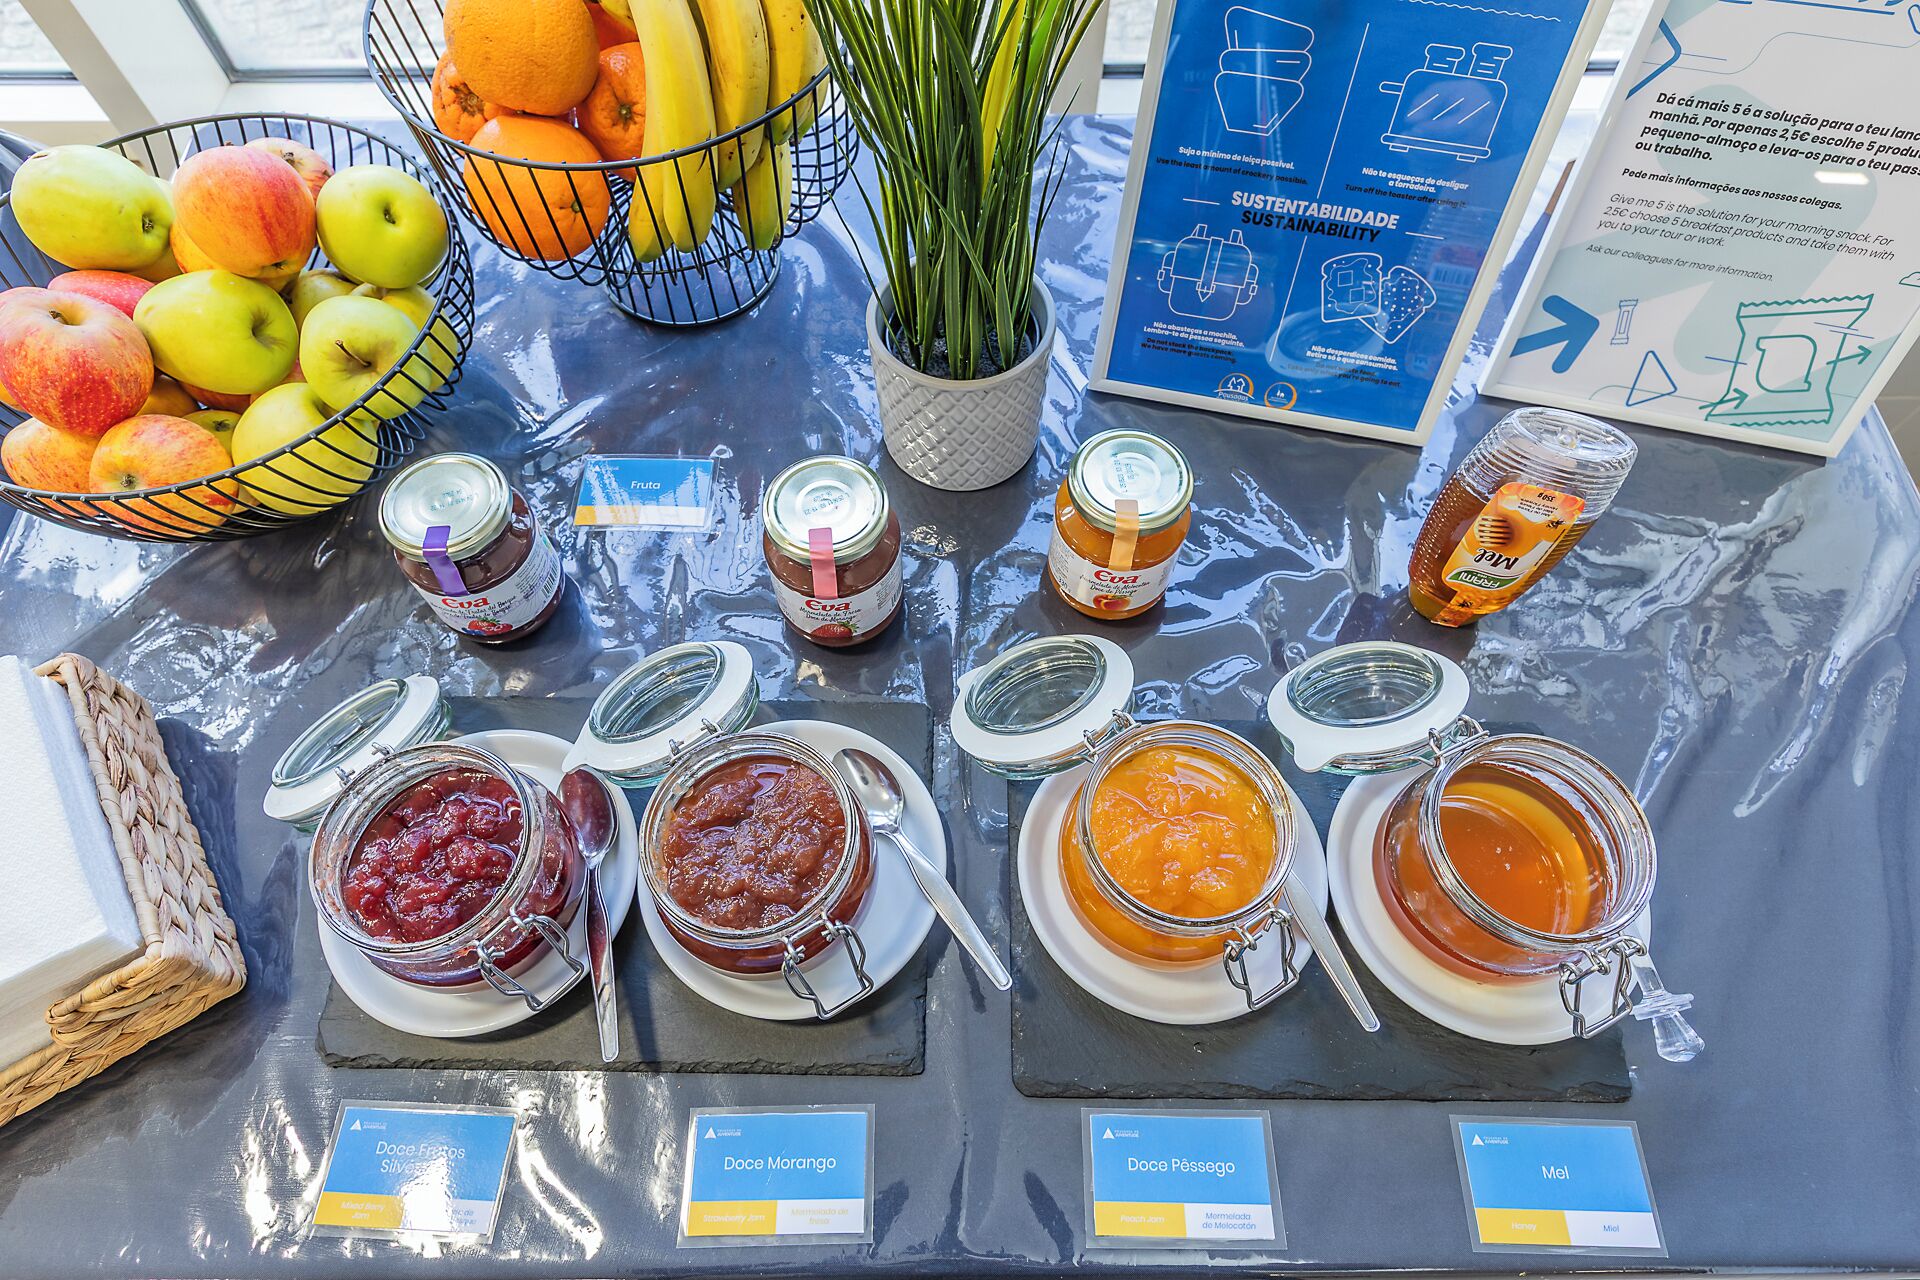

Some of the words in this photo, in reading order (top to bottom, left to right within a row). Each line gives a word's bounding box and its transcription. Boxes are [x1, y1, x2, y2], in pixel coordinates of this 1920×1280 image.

[1656, 92, 1676, 105] Dá
[1677, 96, 1694, 107] cá
[1695, 100, 1730, 112] mais
[1732, 103, 1742, 114] 5
[1742, 104, 1752, 116] é
[1753, 109, 1763, 118] a
[1763, 110, 1819, 127] solução
[1817, 119, 1854, 131] para
[1855, 124, 1864, 133] o
[1865, 124, 1890, 137] teu
[1649, 110, 1700, 126] manhã.
[1702, 116, 1726, 129] Por
[1726, 122, 1778, 138] apenas
[1779, 128, 1810, 142] 2,5€
[1810, 135, 1864, 150] escolhe
[1866, 141, 1877, 151] 5
[1874, 144, 1920, 159] produ
[1634, 139, 1653, 152] ou
[1653, 142, 1713, 161] trabalho.
[1640, 126, 1758, 152] pequeno-almoço
[1758, 144, 1768, 152] e
[1768, 143, 1821, 160] leva-os
[1820, 153, 1856, 165] para
[1856, 159, 1866, 167] o
[1867, 158, 1891, 171] teu
[1622, 168, 1648, 179] Pede
[1648, 173, 1674, 183] mais
[1674, 175, 1741, 194] informações
[1741, 189, 1760, 197] aos
[1761, 192, 1798, 203] nossos
[1799, 196, 1843, 210] colegas.
[1231, 191, 1400, 230] SUSTENTABILIDADE
[1610, 193, 1636, 205] Give
[1635, 198, 1655, 208] me
[1656, 201, 1665, 210] 5
[1665, 201, 1676, 211] is
[1676, 203, 1696, 215] the
[1696, 207, 1741, 222] solution
[1741, 213, 1759, 224] for
[1758, 218, 1786, 230] your
[1785, 222, 1836, 239] morning
[1835, 229, 1872, 244] snack.
[1873, 235, 1895, 247] For
[1241, 210, 1381, 242] SUSTAINABILITY
[1597, 219, 1620, 230] you
[1620, 222, 1632, 231] to
[1632, 225, 1660, 237] your
[1659, 228, 1684, 240] tour
[1683, 234, 1698, 242] or
[1697, 236, 1725, 247] work.
[1629, 210, 1670, 224] choose
[1671, 216, 1681, 226] 5
[1680, 217, 1734, 235] breakfast
[1731, 227, 1785, 243] products
[1785, 235, 1810, 247] and
[1810, 240, 1836, 251] take
[1836, 243, 1868, 256] them
[1869, 249, 1895, 261] with
[1586, 244, 1602, 253] Ask
[1603, 247, 1621, 256] our
[1621, 249, 1674, 265] colleagues
[1673, 257, 1689, 268] for
[1689, 261, 1716, 272] more
[1715, 264, 1774, 282] information.
[630, 480, 661, 490] Fruta
[1474, 547, 1519, 571] Mel
[1094, 570, 1141, 584] Eva
[442, 597, 490, 609] Eva
[805, 599, 851, 612] Eva
[376, 1141, 416, 1156] Doce
[724, 1157, 764, 1170] Doce
[768, 1156, 837, 1174] Morango
[1128, 1157, 1168, 1172] Doce
[1171, 1158, 1236, 1177] Pêssego
[1541, 1165, 1570, 1180] Mel
[1205, 1212, 1251, 1220] Mermelada
[1214, 1222, 1256, 1230] Melocotón
[1603, 1224, 1620, 1233] Miel
